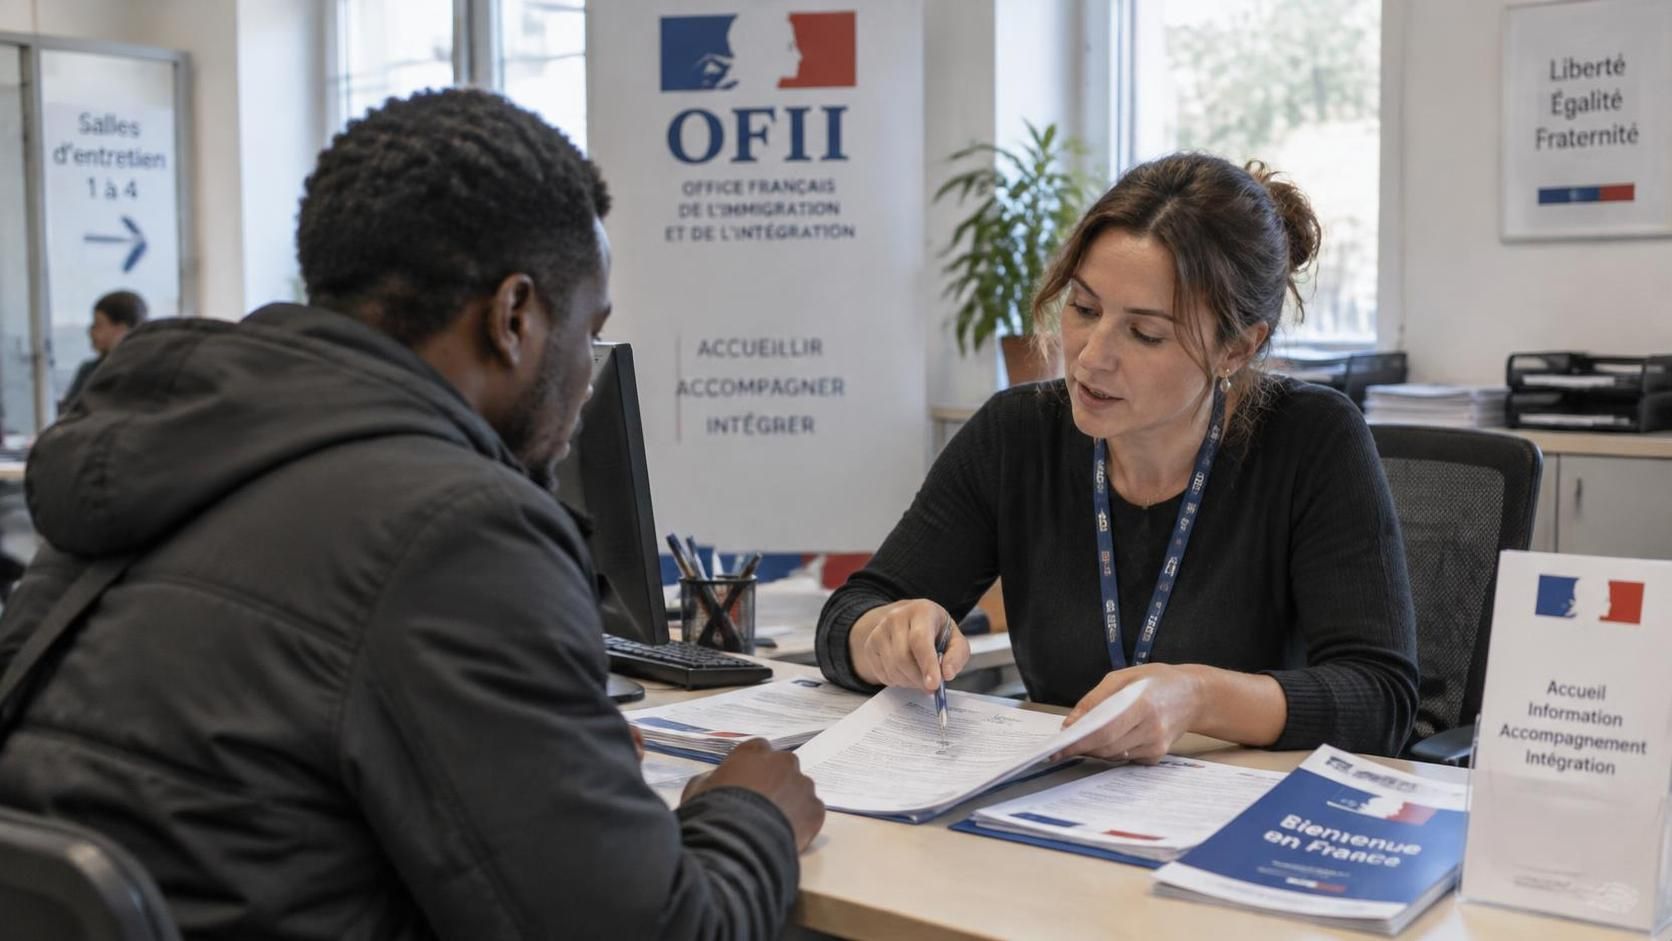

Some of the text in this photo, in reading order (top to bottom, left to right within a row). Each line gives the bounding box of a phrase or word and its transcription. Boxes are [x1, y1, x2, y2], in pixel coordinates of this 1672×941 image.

[1550, 53, 1626, 82] Liberté
[1551, 88, 1623, 120] Égalité
[78, 111, 140, 137] Salles
[666, 105, 849, 164] OFII
[1535, 122, 1639, 150] Fraternité
[53, 141, 167, 169] d'entretien
[87, 176, 138, 200] 1 à 4
[682, 177, 836, 198] OFFICE FRANÇAIS
[678, 200, 840, 218] DE L'IMMIGRATION
[665, 221, 855, 242] ET DE L'INTÉGRATION
[697, 337, 823, 359] ACCUEILLIR
[676, 377, 845, 399] ACCOMPAGNER
[706, 411, 816, 436] INTÉGRER
[1547, 680, 1607, 701] Accueil
[1528, 702, 1623, 727] Information
[1499, 723, 1647, 755] Accompagnement
[1525, 749, 1616, 776] Intégration
[1263, 830, 1401, 868] en France
